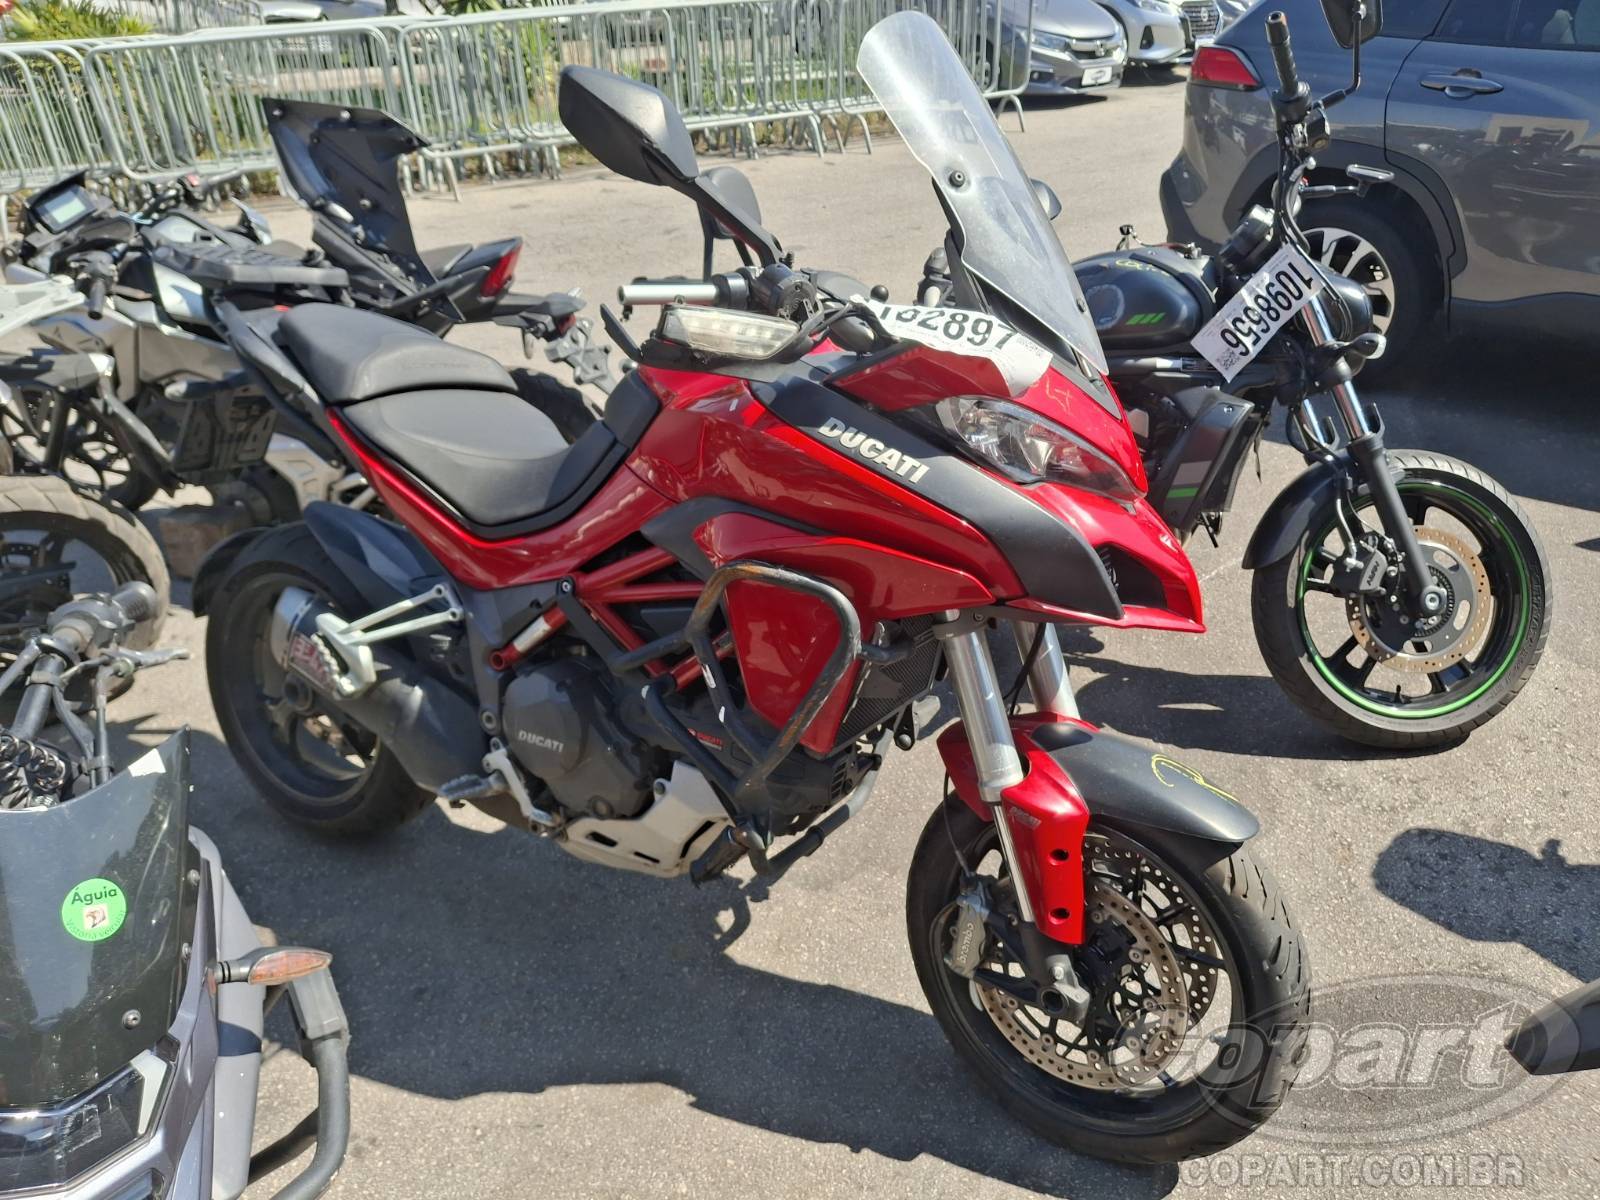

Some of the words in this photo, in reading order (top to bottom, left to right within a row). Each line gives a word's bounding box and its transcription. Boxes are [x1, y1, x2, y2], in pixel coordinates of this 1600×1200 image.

[1220, 262, 1314, 357] 1098656
[818, 416, 930, 484] DUCATI
[518, 729, 565, 753] DUCATI
[71, 886, 117, 905] Águia
[956, 922, 975, 964] brembo
